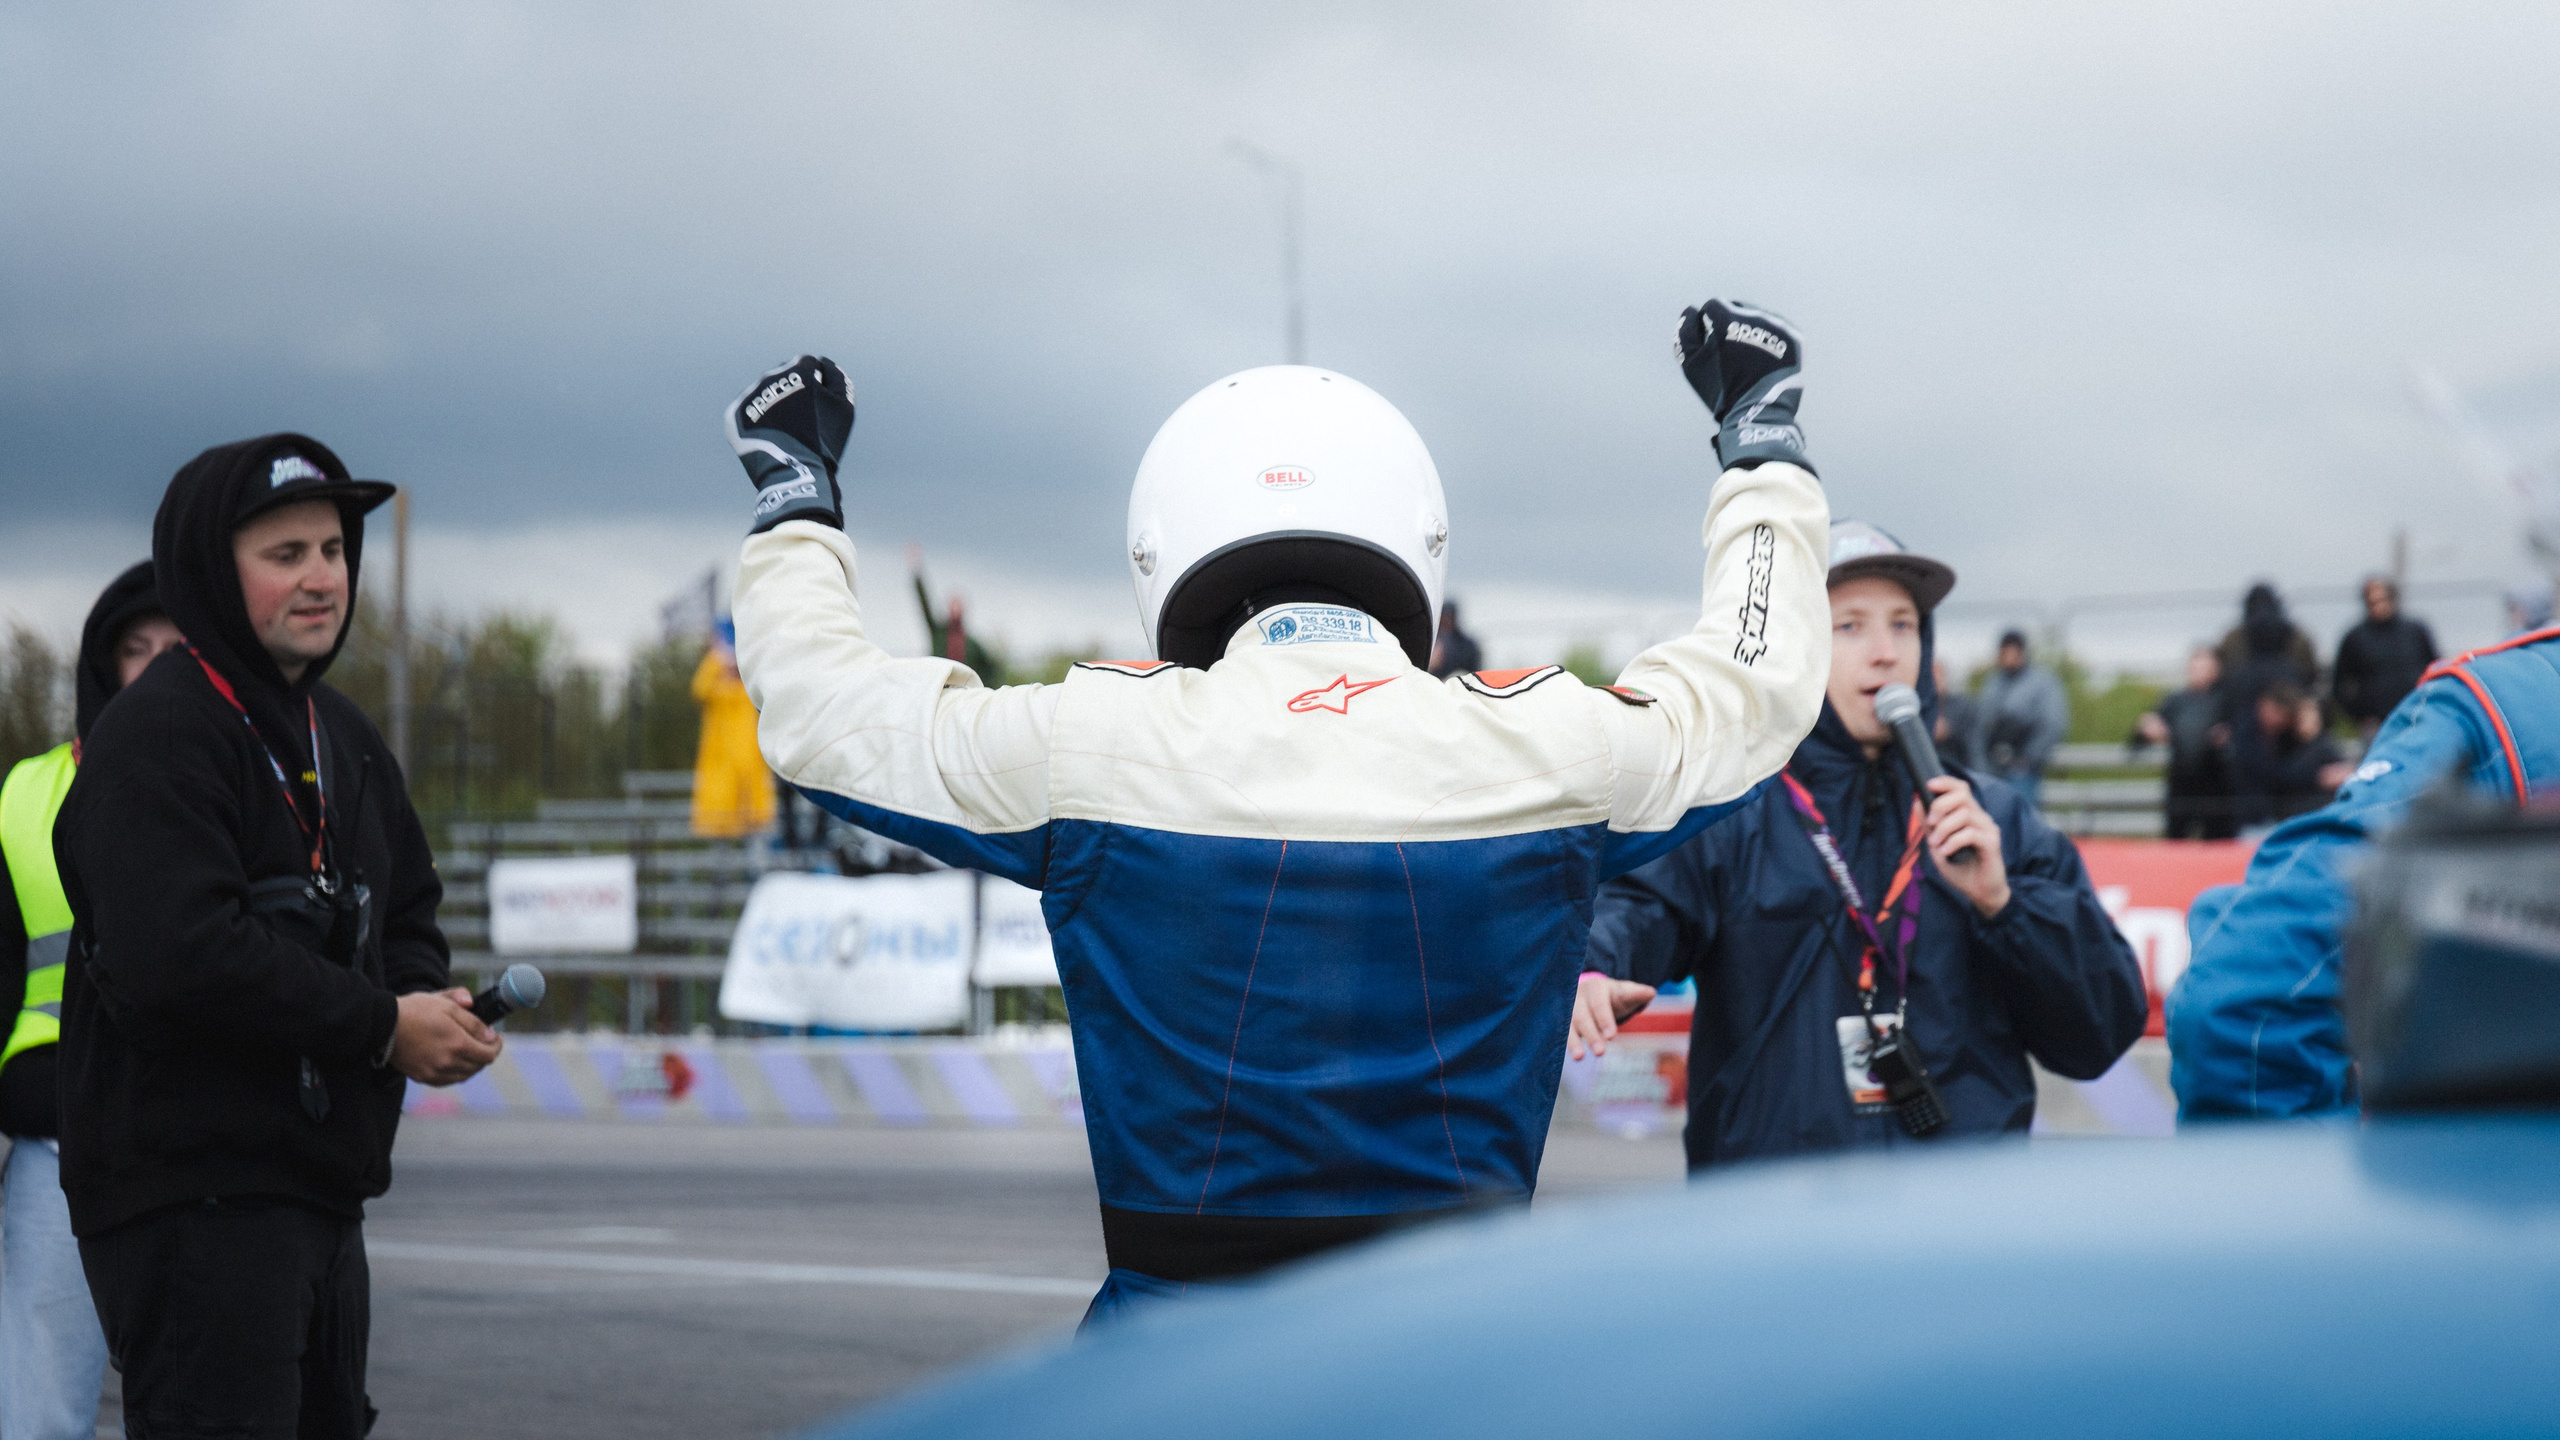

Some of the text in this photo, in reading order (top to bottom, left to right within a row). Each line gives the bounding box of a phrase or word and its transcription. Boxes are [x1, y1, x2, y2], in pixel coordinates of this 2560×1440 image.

[1725, 321, 1787, 360] sparco
[745, 372, 806, 423] sparco
[1265, 472, 1307, 483] BELL
[752, 484, 819, 519] parco
